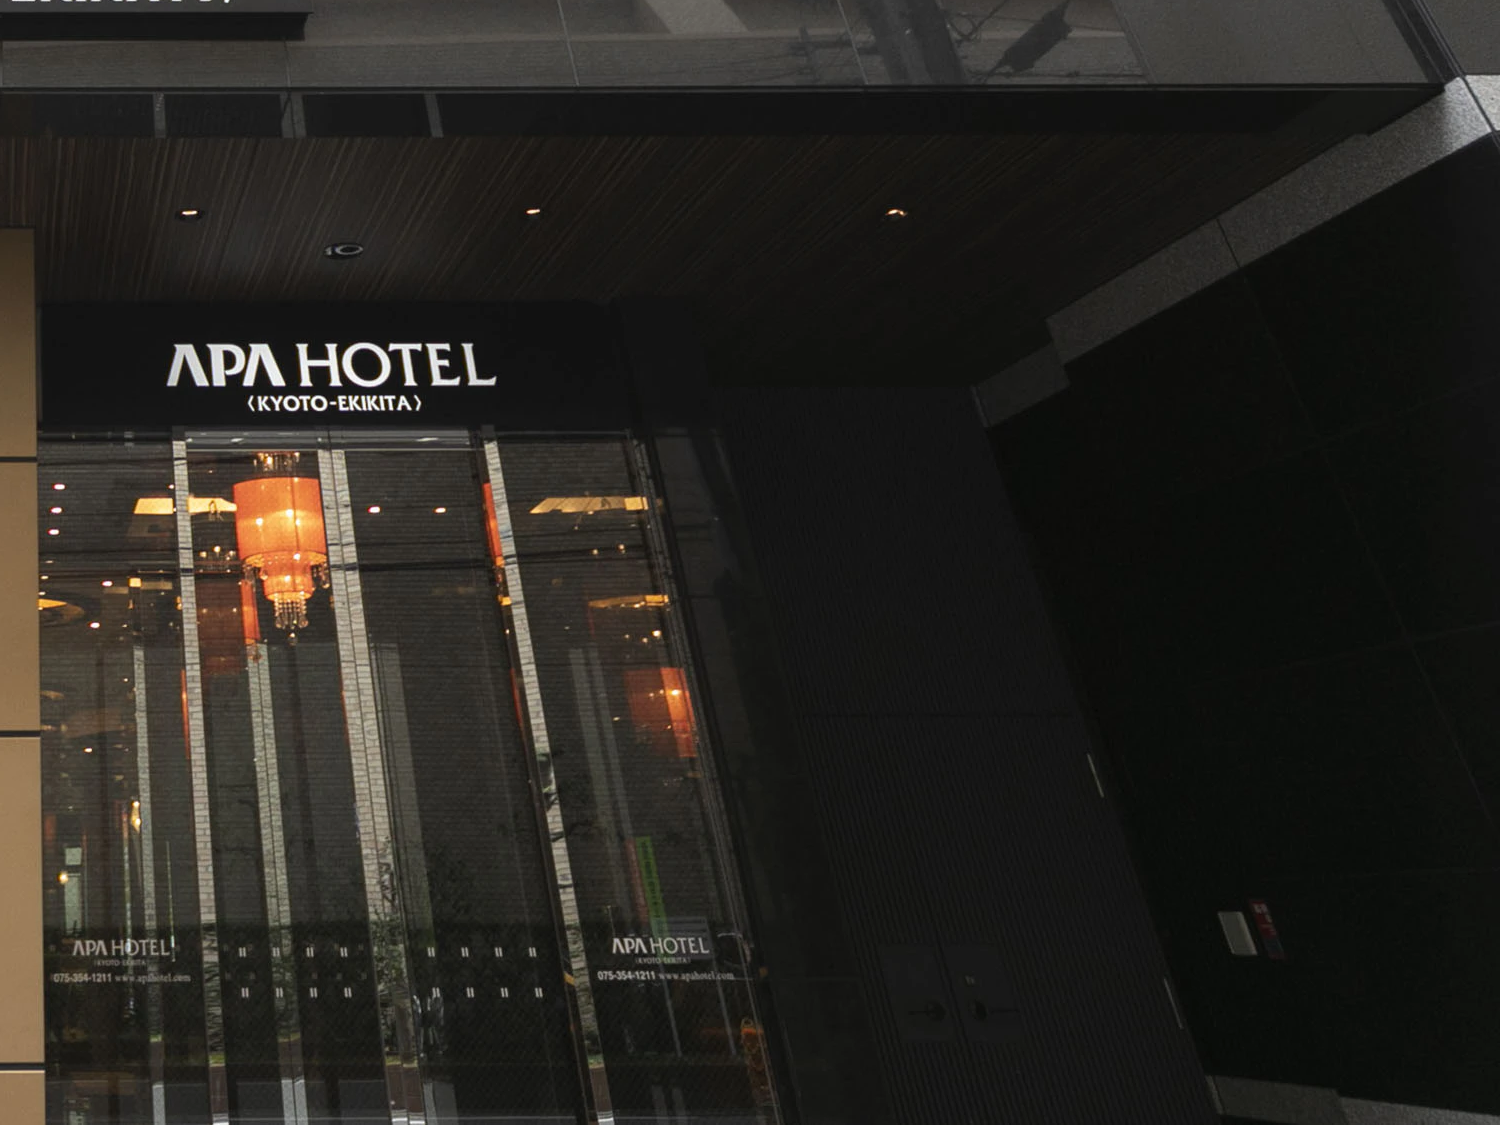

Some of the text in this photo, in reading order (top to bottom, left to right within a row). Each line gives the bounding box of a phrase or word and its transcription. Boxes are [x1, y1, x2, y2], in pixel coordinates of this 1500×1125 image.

[166, 341, 498, 388] APA HOTEL
[72, 938, 171, 956] APA HOTEL
[611, 937, 710, 954] APA HOTEL
[52, 973, 112, 983] 075-354-1211
[597, 971, 656, 981] 075-354-1211
